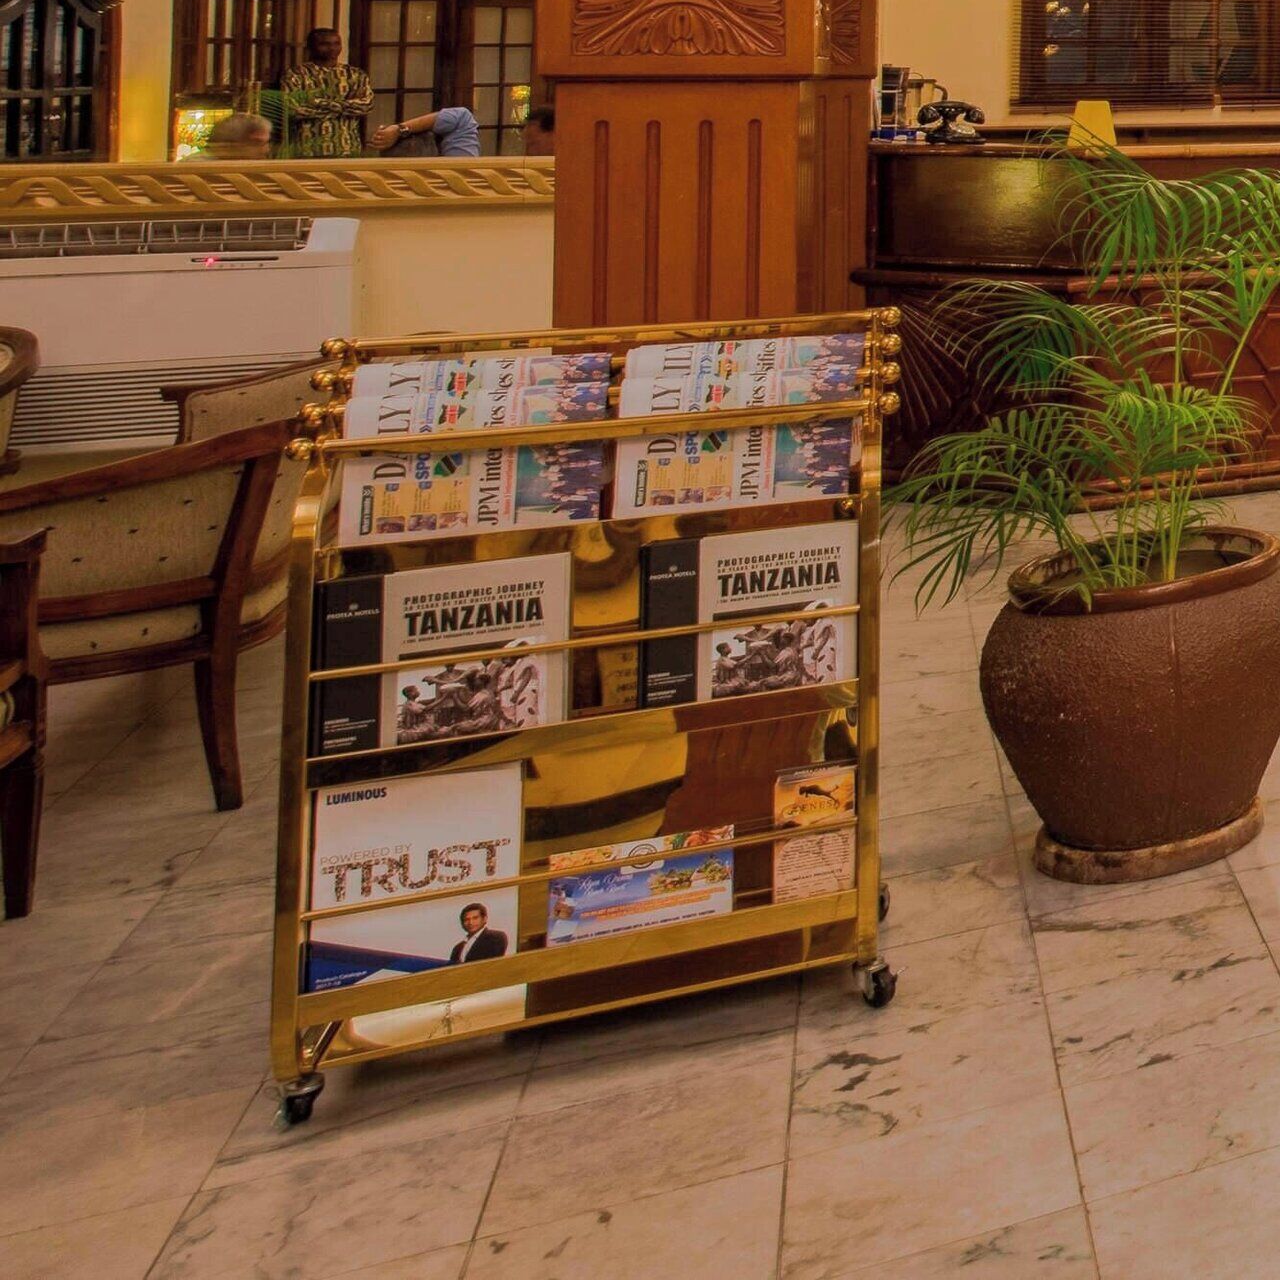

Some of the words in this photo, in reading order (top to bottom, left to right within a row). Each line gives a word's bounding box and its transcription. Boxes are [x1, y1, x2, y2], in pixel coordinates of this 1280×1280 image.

[740, 462, 761, 499] JPM
[477, 486, 499, 525] JPM
[718, 551, 795, 567] PHOTOGRAPHIC
[799, 546, 842, 558] JOURNEY
[404, 587, 492, 605] PHOTOGRAPHIC
[498, 580, 545, 594] JOURNEY
[718, 561, 840, 597] TANZANIA
[405, 597, 544, 637] TANZANIA
[326, 787, 388, 806] LUMINOUS
[320, 847, 391, 865] POWERED
[395, 843, 413, 854] BY
[321, 838, 511, 902] TRUST
